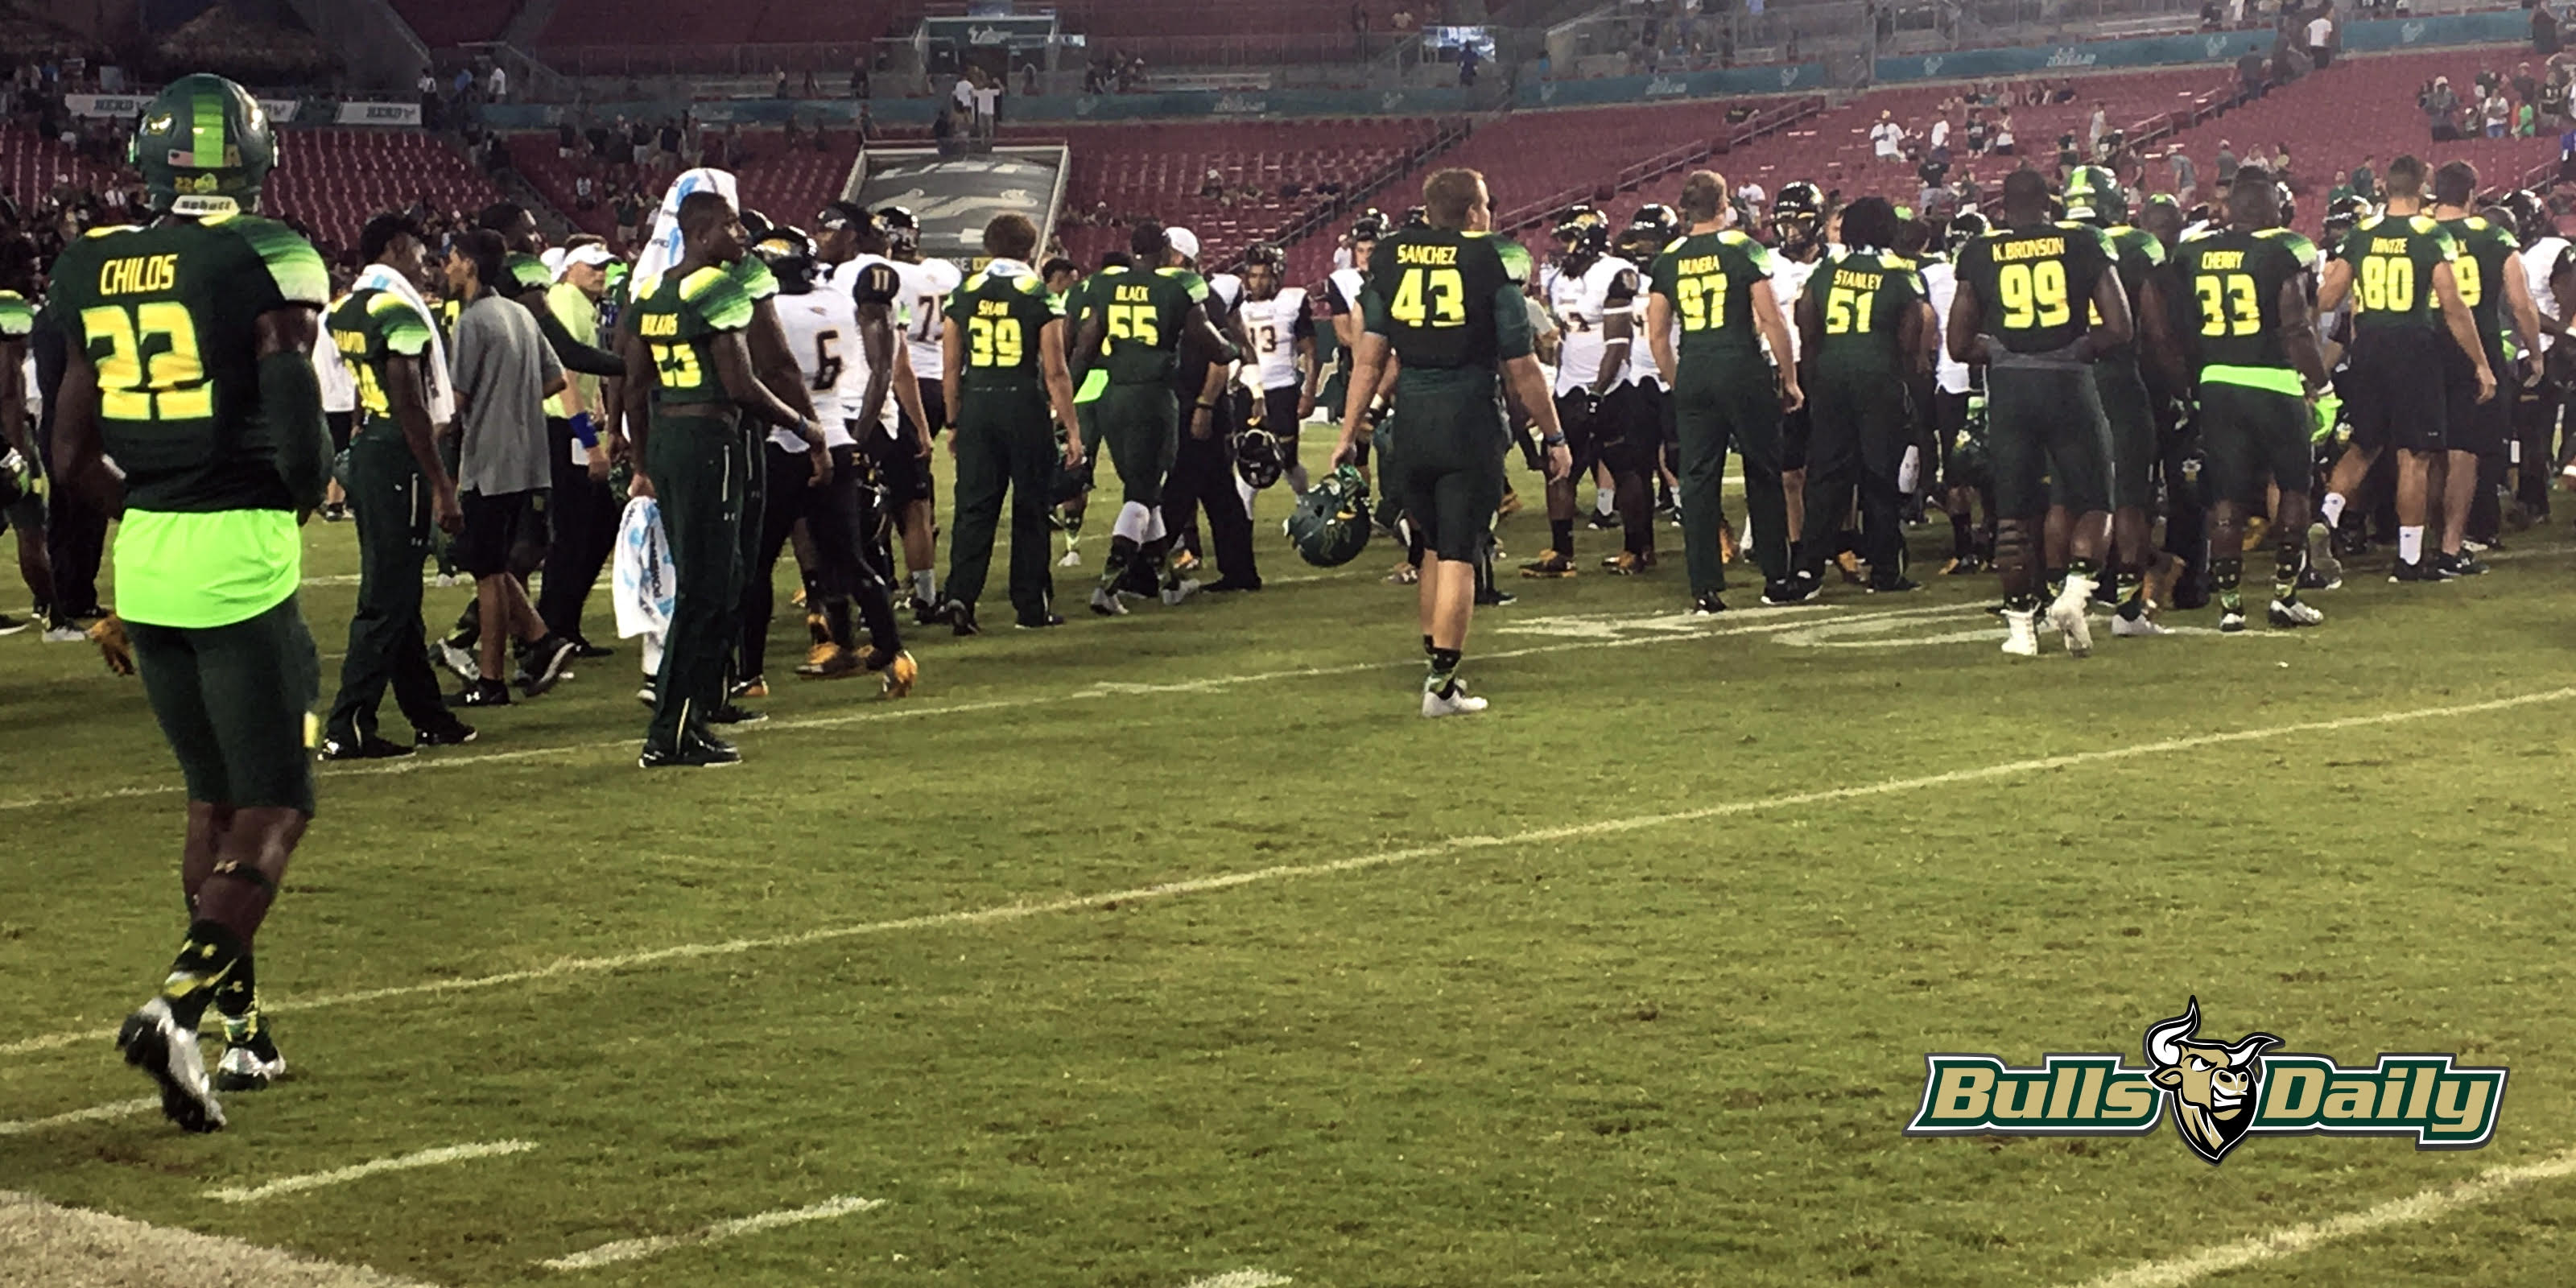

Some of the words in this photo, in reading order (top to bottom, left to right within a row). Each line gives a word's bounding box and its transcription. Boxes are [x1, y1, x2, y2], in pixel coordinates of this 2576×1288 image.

[1397, 244, 1457, 265] SANCHEZ
[1992, 237, 2065, 262] K.BRONSON
[2202, 251, 2245, 270] CHERRY
[872, 269, 889, 291] 11
[1391, 268, 1465, 327] 43
[1677, 273, 1728, 331] 97
[1834, 268, 1883, 291] STANLEY
[2000, 260, 2070, 328] 99
[2362, 255, 2413, 312] 80
[1108, 304, 1158, 346] 55
[1826, 287, 1873, 334] 51
[2196, 275, 2260, 336] 33
[80, 301, 213, 421] 22
[811, 329, 842, 390] 6
[968, 316, 1022, 367] 39
[1249, 324, 1277, 353] 13
